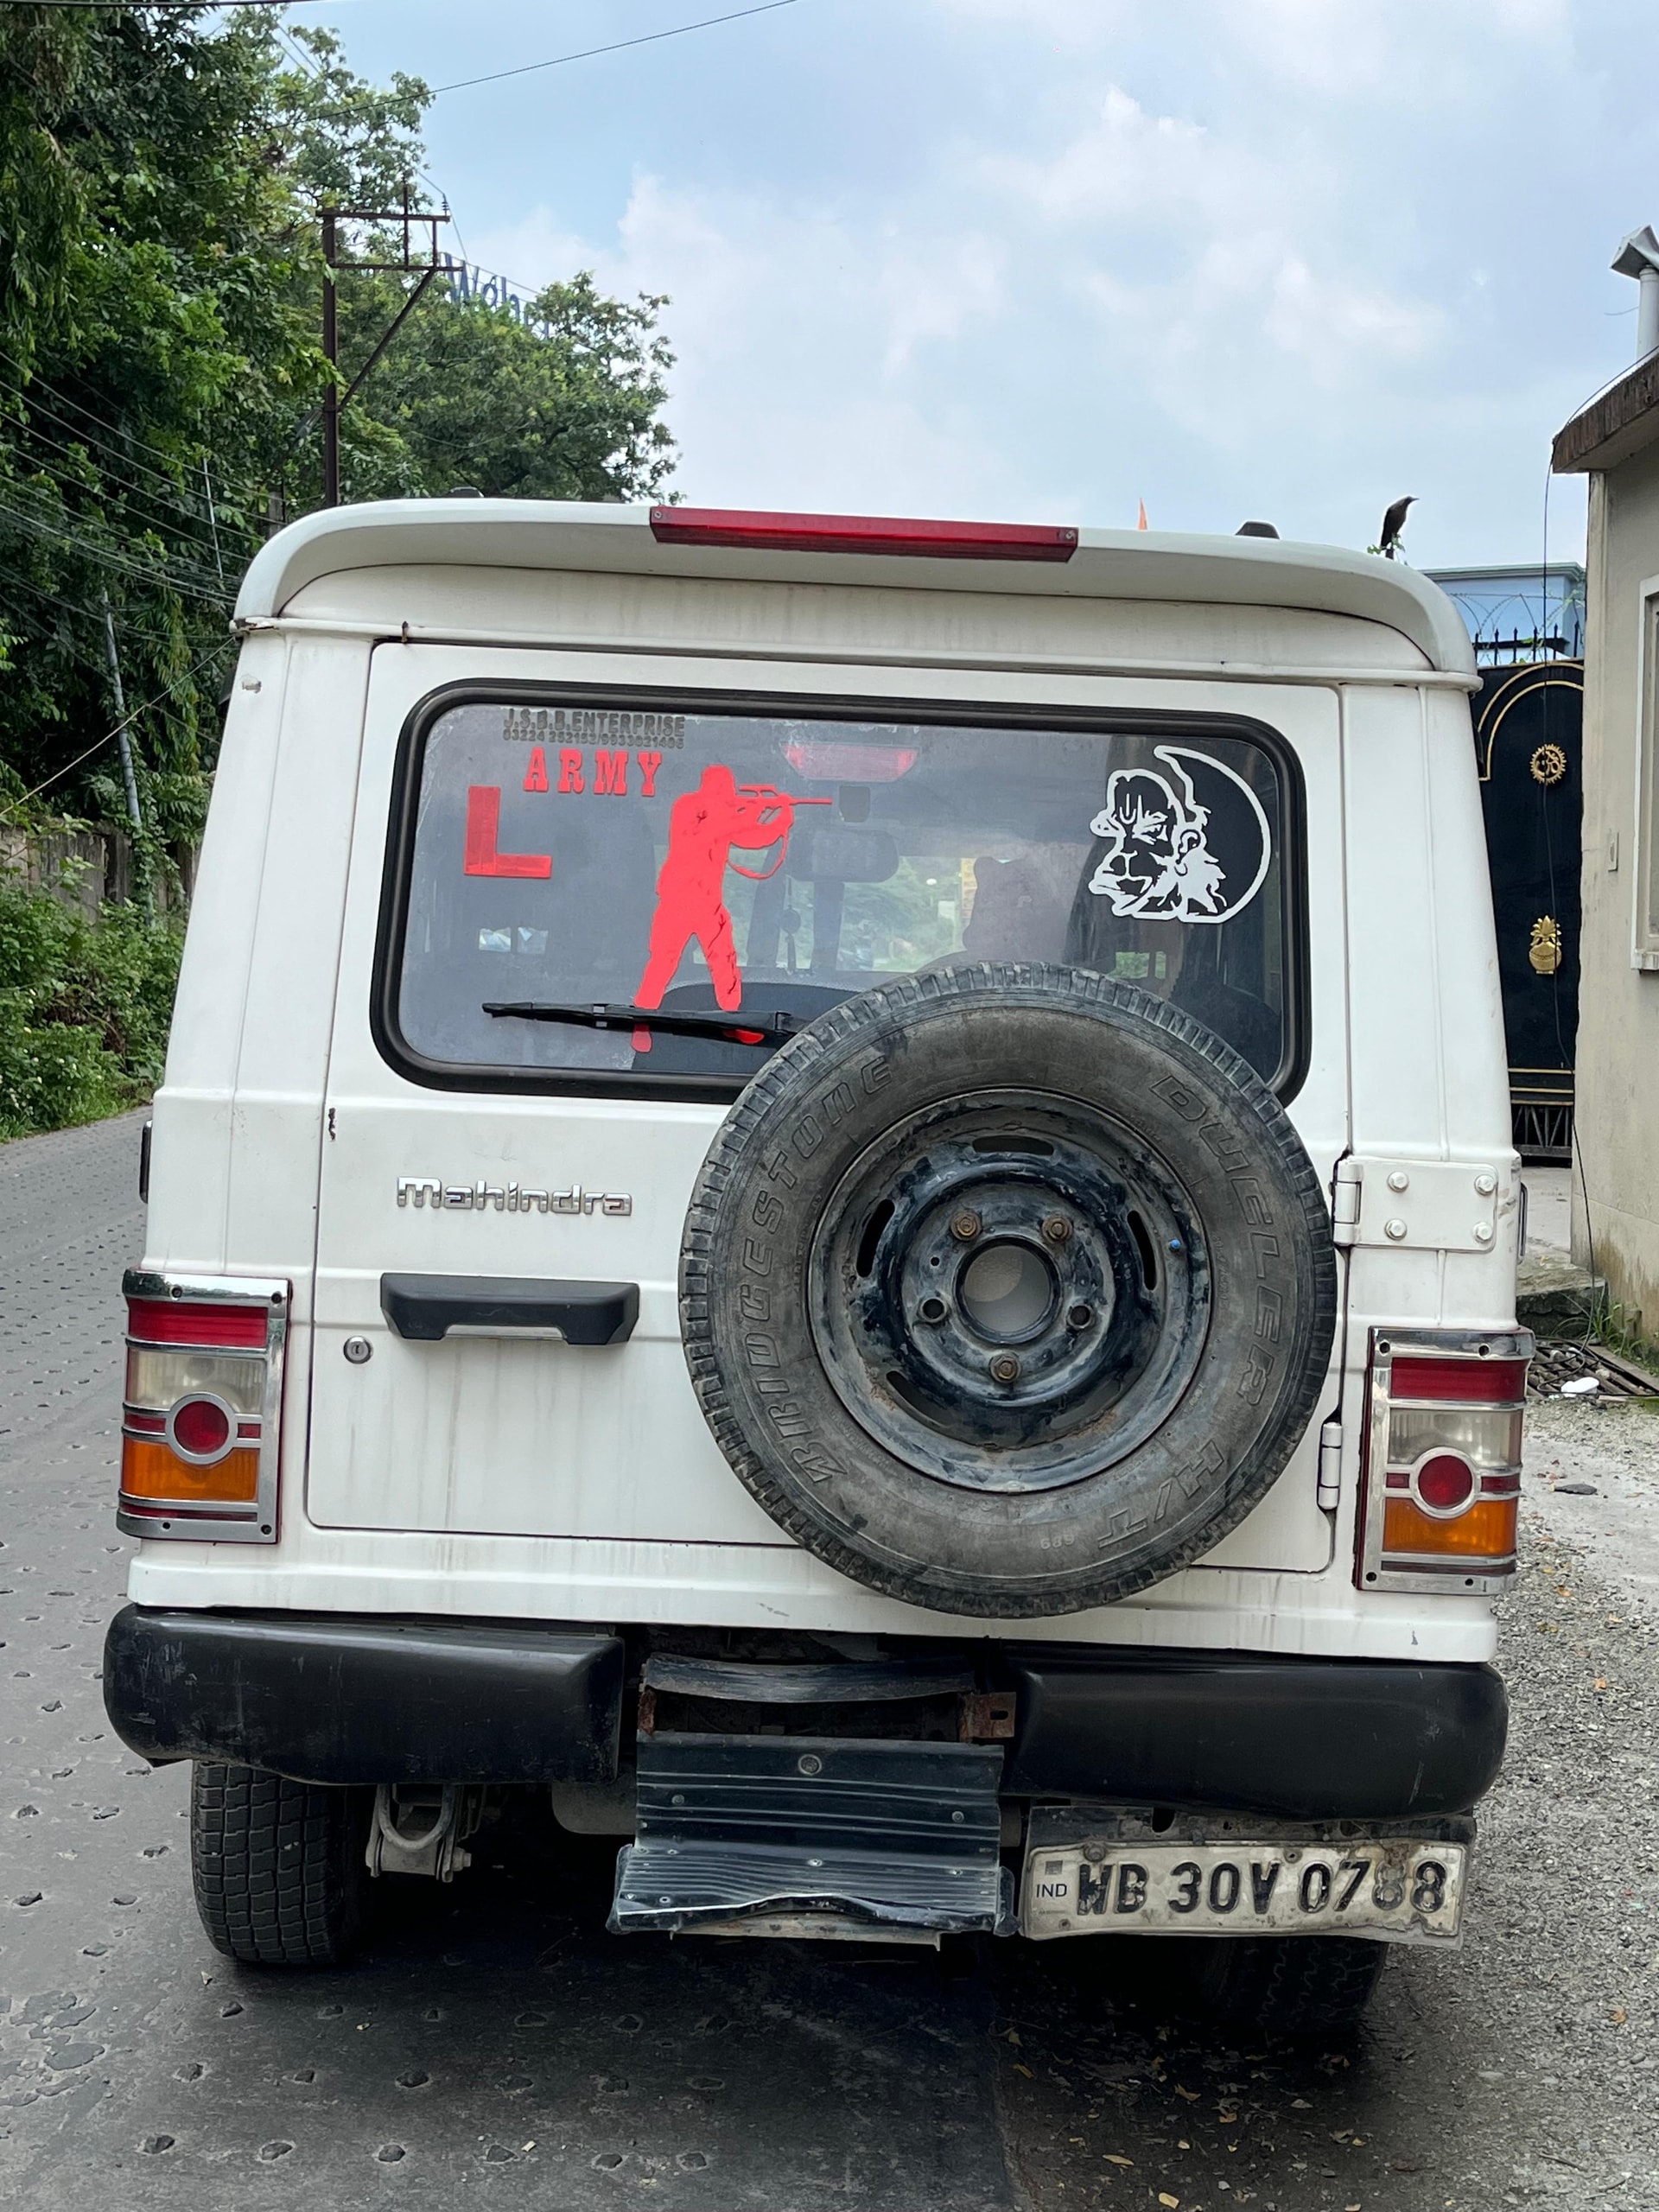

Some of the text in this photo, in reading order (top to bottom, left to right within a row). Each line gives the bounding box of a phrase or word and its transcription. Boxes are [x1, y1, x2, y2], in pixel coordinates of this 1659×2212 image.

[523, 747, 662, 796] ARMY
[465, 785, 552, 878] L
[397, 1176, 632, 1216] Mahindra
[737, 1054, 893, 1483] BRIDGESTONE
[1151, 1076, 1282, 1405] DUELER
[1036, 1884, 1068, 1898] IND
[1077, 1861, 1149, 1915] WB
